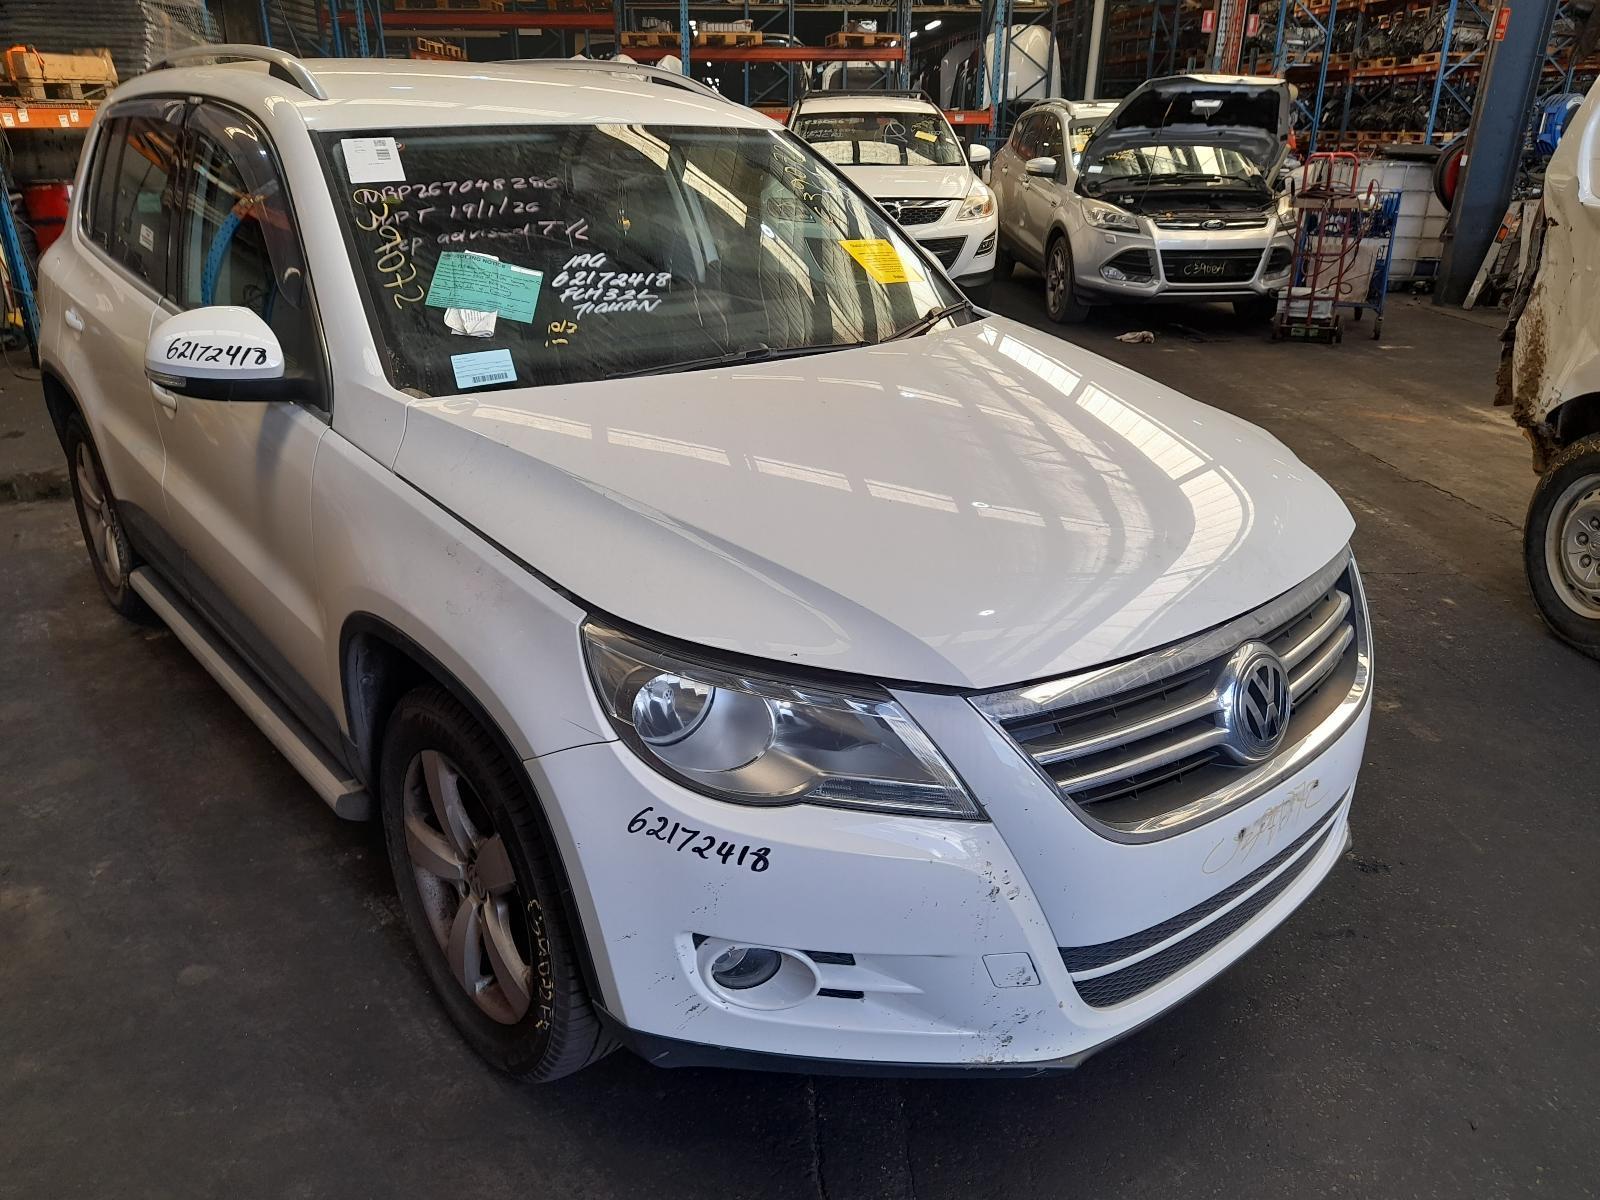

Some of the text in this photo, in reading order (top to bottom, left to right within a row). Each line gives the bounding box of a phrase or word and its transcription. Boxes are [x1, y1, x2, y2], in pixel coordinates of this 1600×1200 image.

[563, 252, 607, 270] IAG
[166, 337, 267, 367] 62172418
[626, 806, 771, 872] 62172418
